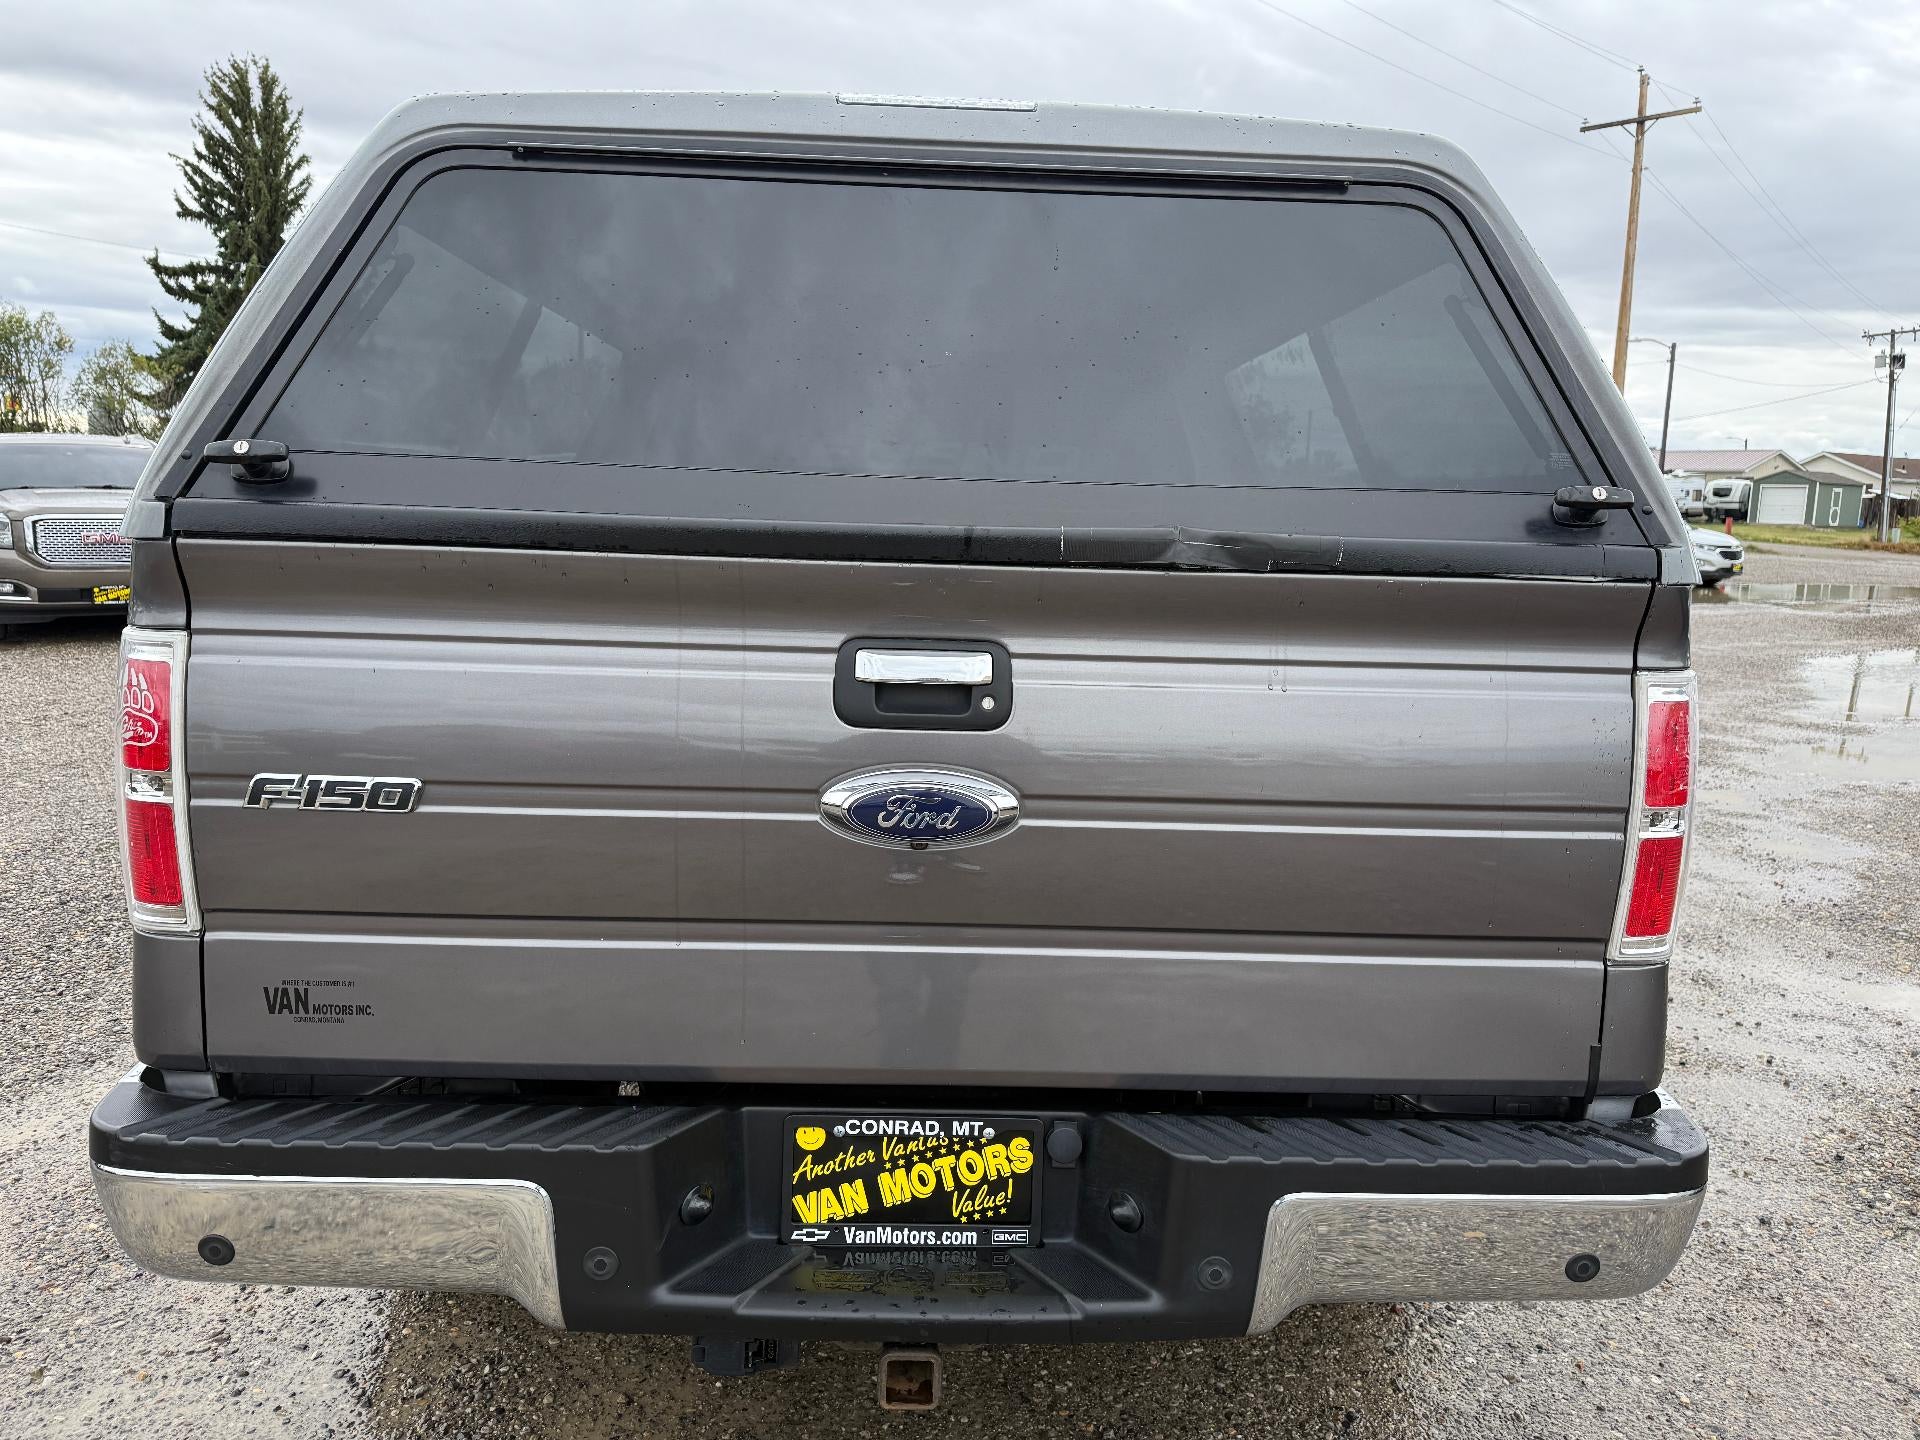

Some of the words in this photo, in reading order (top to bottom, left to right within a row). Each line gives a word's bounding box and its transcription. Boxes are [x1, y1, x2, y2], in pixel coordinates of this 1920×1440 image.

[242, 773, 424, 814] F-150
[877, 795, 962, 829] Ford
[301, 979, 312, 987] THE
[263, 987, 309, 1014] VAN
[312, 1003, 354, 1015] MOTORS
[355, 1005, 375, 1016] INC.
[845, 1120, 944, 1138] CONRAD,
[952, 1121, 984, 1136] MT
[792, 1146, 876, 1184] Another
[792, 1179, 869, 1224] VAN
[877, 1137, 1034, 1208] MOTORS
[952, 1178, 1013, 1218] Value!
[843, 1226, 978, 1246] VanMotors.com
[992, 1232, 1028, 1243] GMC
